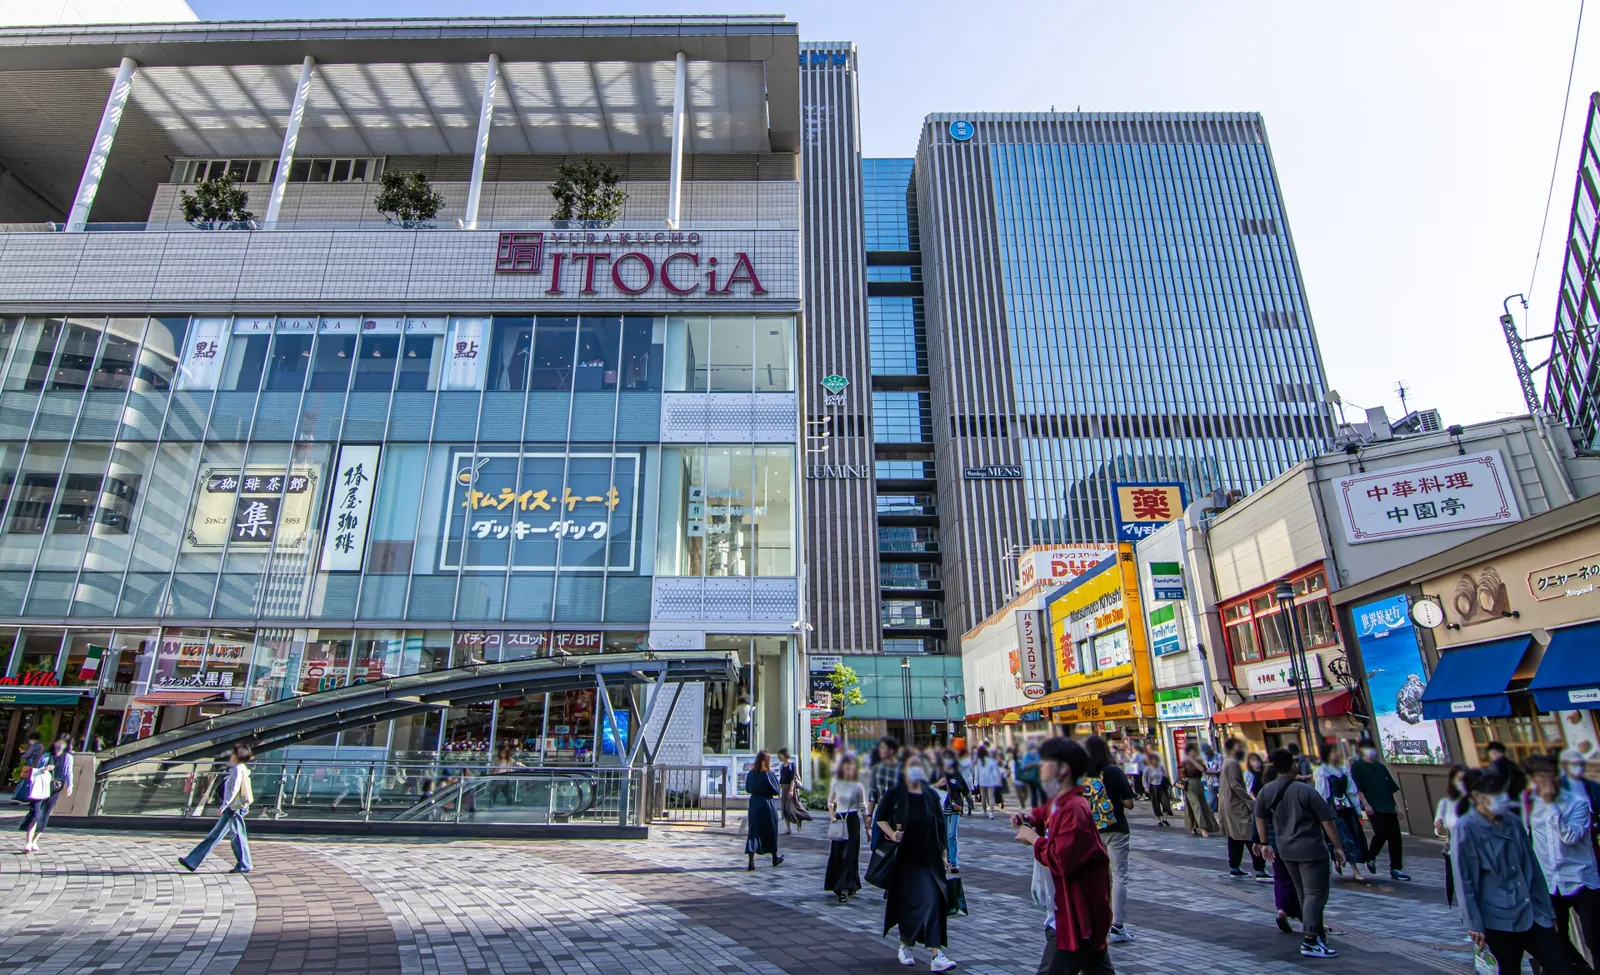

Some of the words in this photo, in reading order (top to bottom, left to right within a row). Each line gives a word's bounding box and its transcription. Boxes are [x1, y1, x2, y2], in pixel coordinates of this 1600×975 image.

[551, 232, 700, 244] YURAKUCHO
[545, 251, 768, 295] ITOCiA
[252, 320, 342, 330] KAMONKA
[395, 320, 428, 330] TEN
[824, 394, 847, 407] 松竹
[806, 464, 870, 479] LUMINE
[220, 476, 306, 491] 珈琲茶館
[1366, 471, 1474, 502] 中華料理
[334, 462, 369, 555] 椿屋珈琲
[1131, 488, 1171, 519] 薬
[1386, 497, 1466, 523] 中園亭
[236, 501, 273, 538] 集
[471, 519, 608, 540] ダッキーダック
[1024, 613, 1034, 644] パチンコ
[1153, 623, 1177, 637] FamilyMart
[457, 632, 500, 645] パチンコ
[508, 633, 548, 645] スロット
[556, 633, 600, 646] 1F/B1F
[1027, 647, 1037, 679] スロット
[23, 671, 58, 687] Villa
[1168, 702, 1193, 714] FamilyMart
